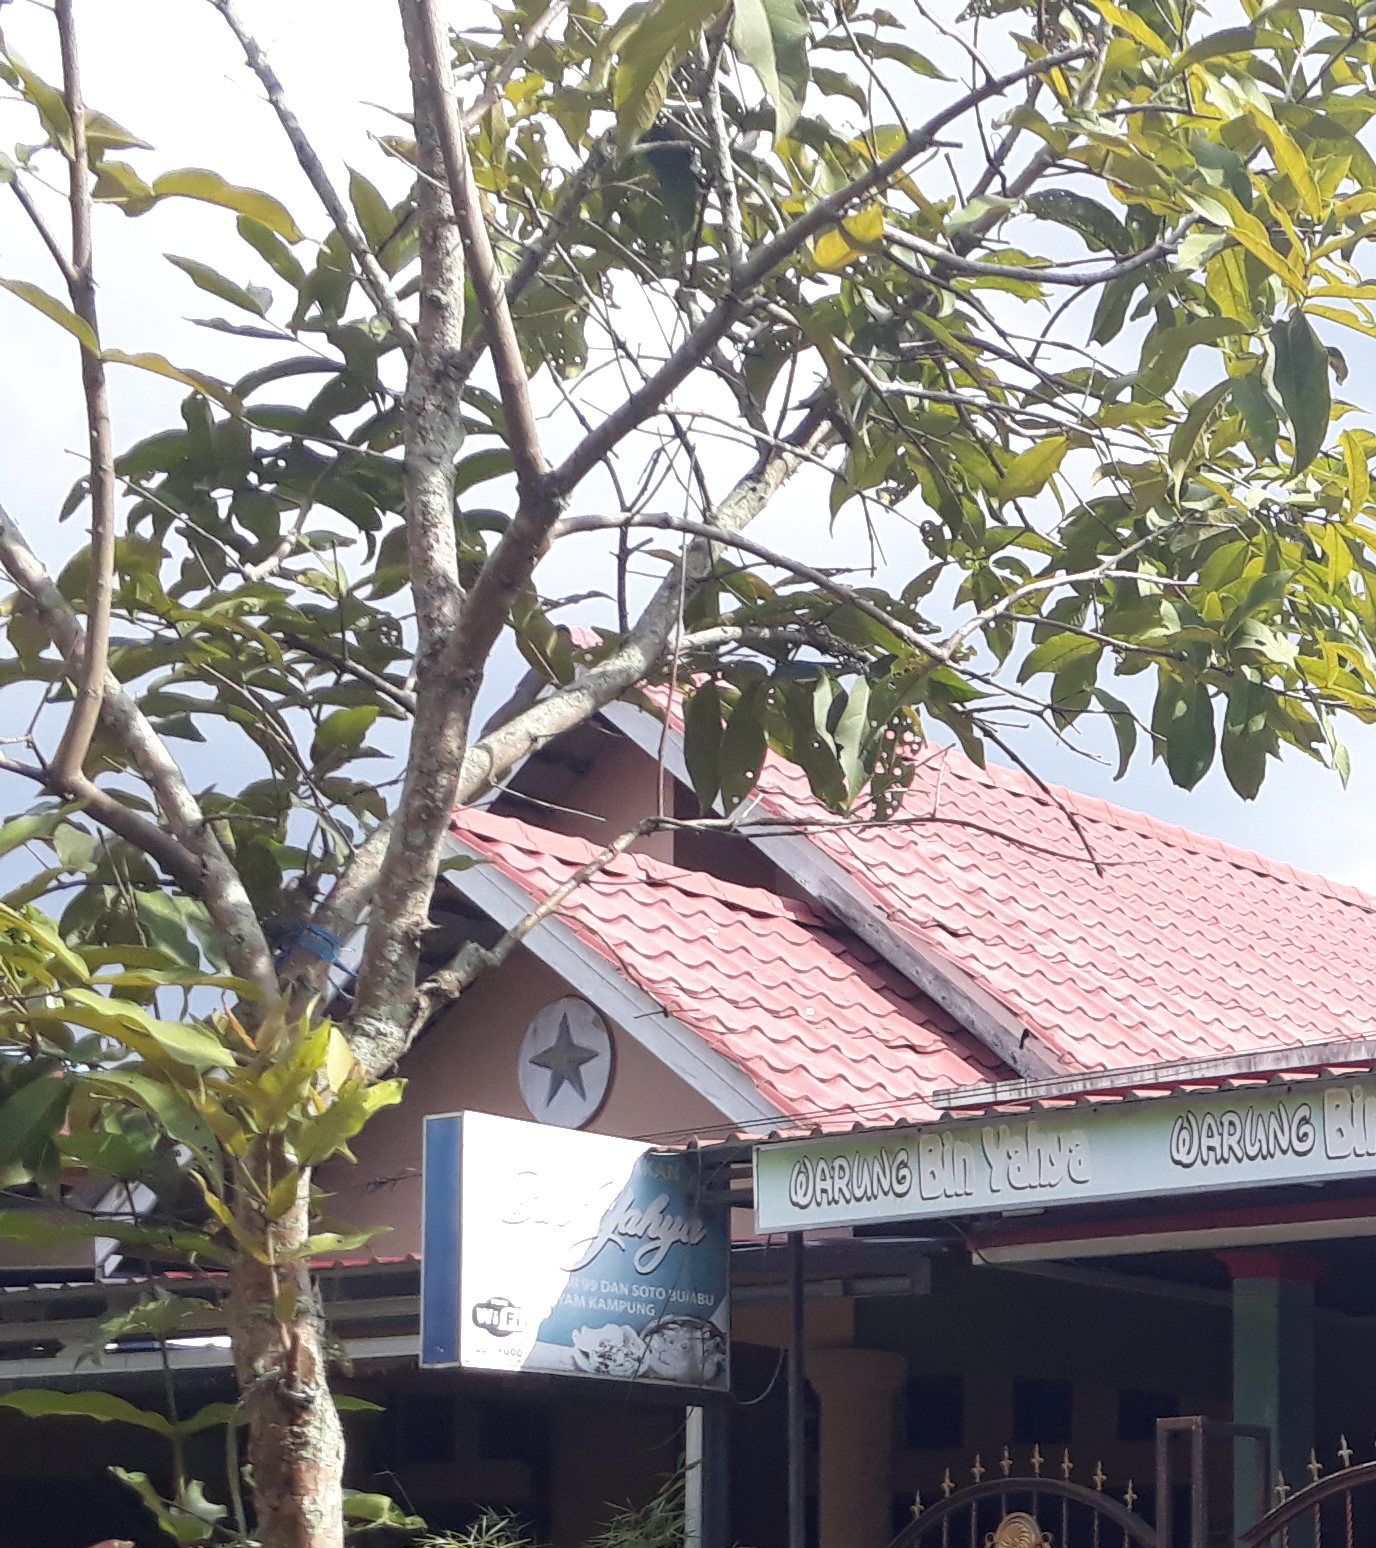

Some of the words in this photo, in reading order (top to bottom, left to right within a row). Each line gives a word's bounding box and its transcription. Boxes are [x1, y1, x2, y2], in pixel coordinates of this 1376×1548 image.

[1169, 1100, 1316, 1169] WARUNG
[789, 1146, 912, 1210] WARUNG
[918, 1130, 976, 1201] Bin
[588, 1297, 656, 1317] KAMPUNG
[601, 1280, 629, 1296] DAN
[631, 1284, 666, 1300] SOTO
